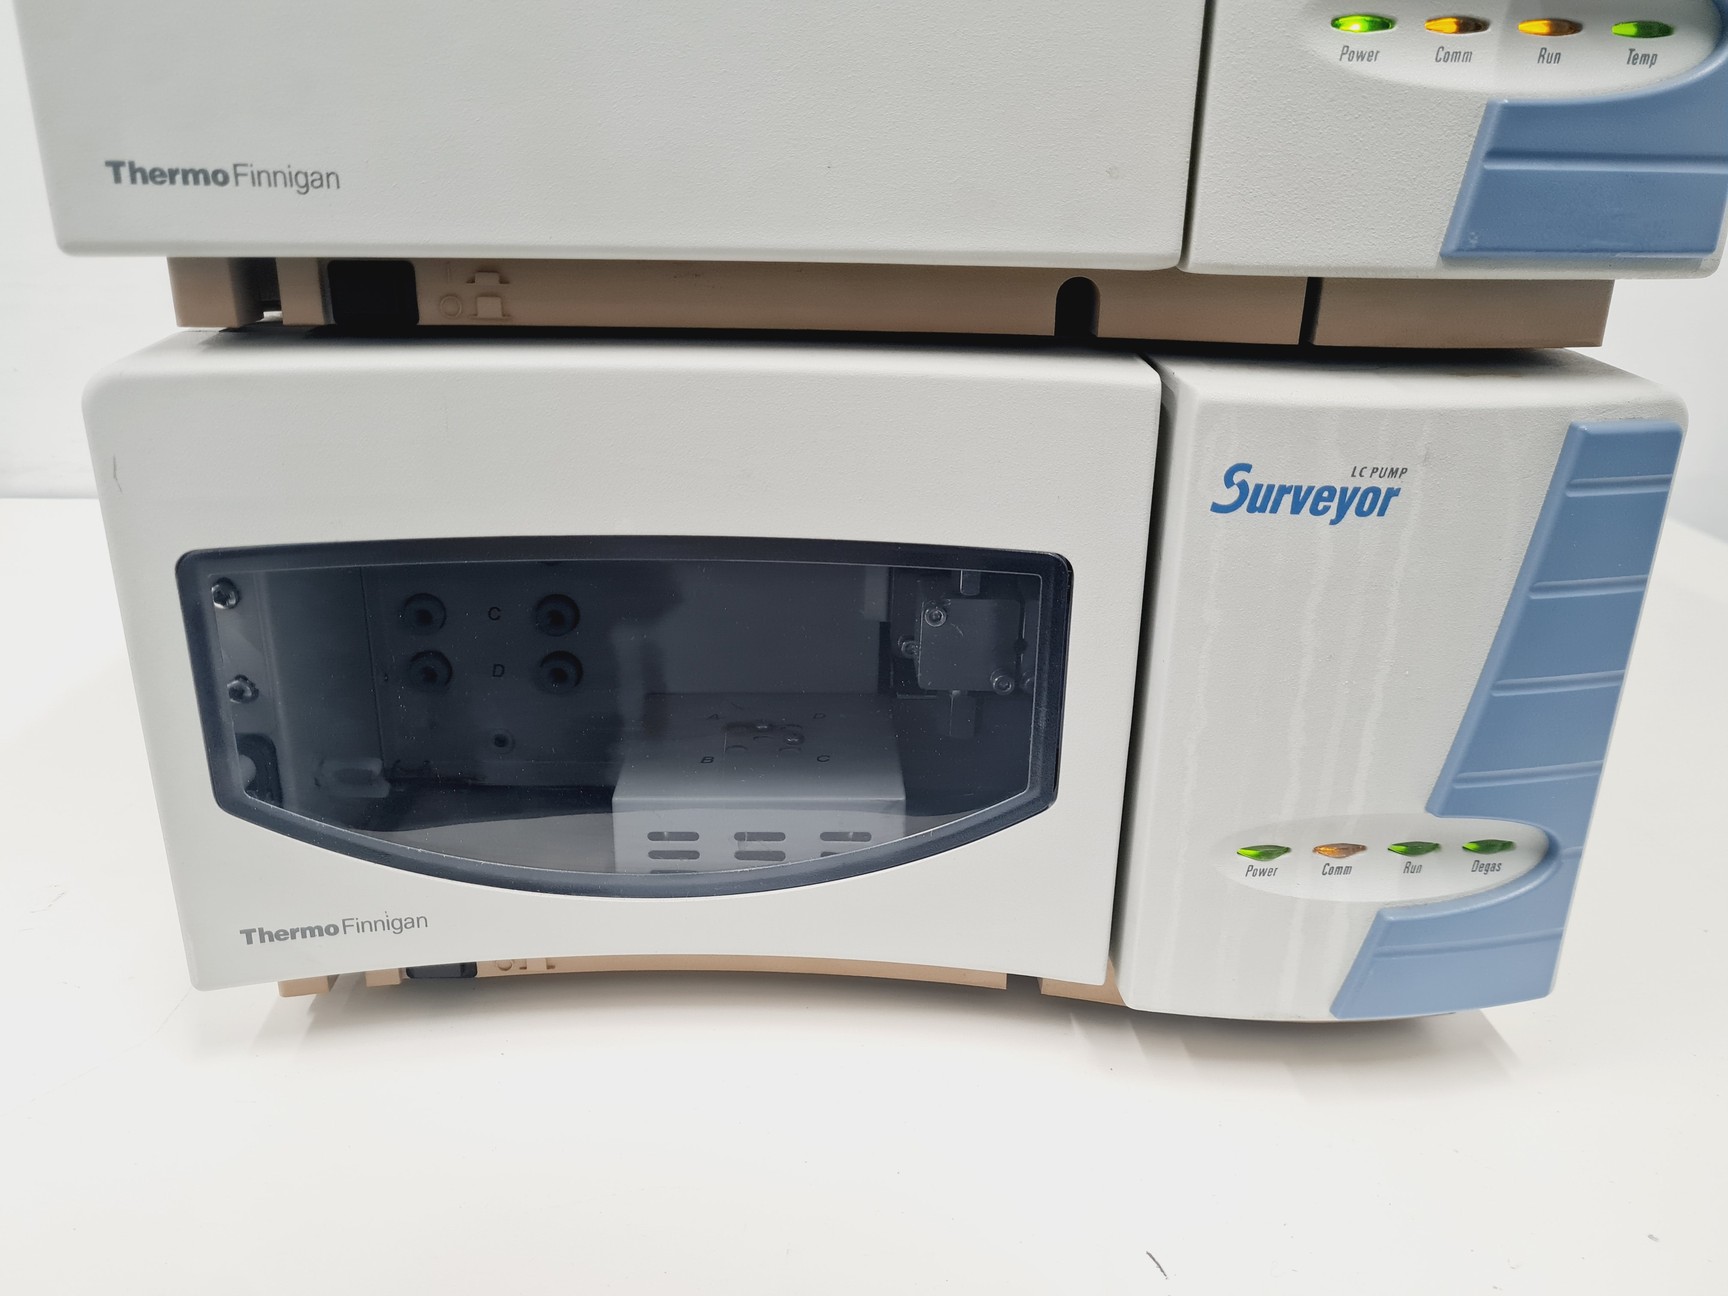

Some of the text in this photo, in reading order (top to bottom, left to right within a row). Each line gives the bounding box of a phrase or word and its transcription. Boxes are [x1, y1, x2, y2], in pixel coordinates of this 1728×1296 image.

[1339, 45, 1381, 63] Power
[1435, 46, 1473, 64] Comm
[1537, 47, 1562, 65] Run
[1626, 48, 1659, 68] Temp
[1351, 466, 1408, 479] LC PUMP
[1210, 462, 1402, 525] Surveyor
[488, 606, 501, 621] C
[492, 663, 506, 678] D
[700, 755, 715, 764] B
[816, 754, 831, 763] C
[1245, 864, 1278, 878] Power
[1321, 862, 1353, 876] Comm
[1403, 861, 1423, 875] Run
[1471, 859, 1503, 874] Degas
